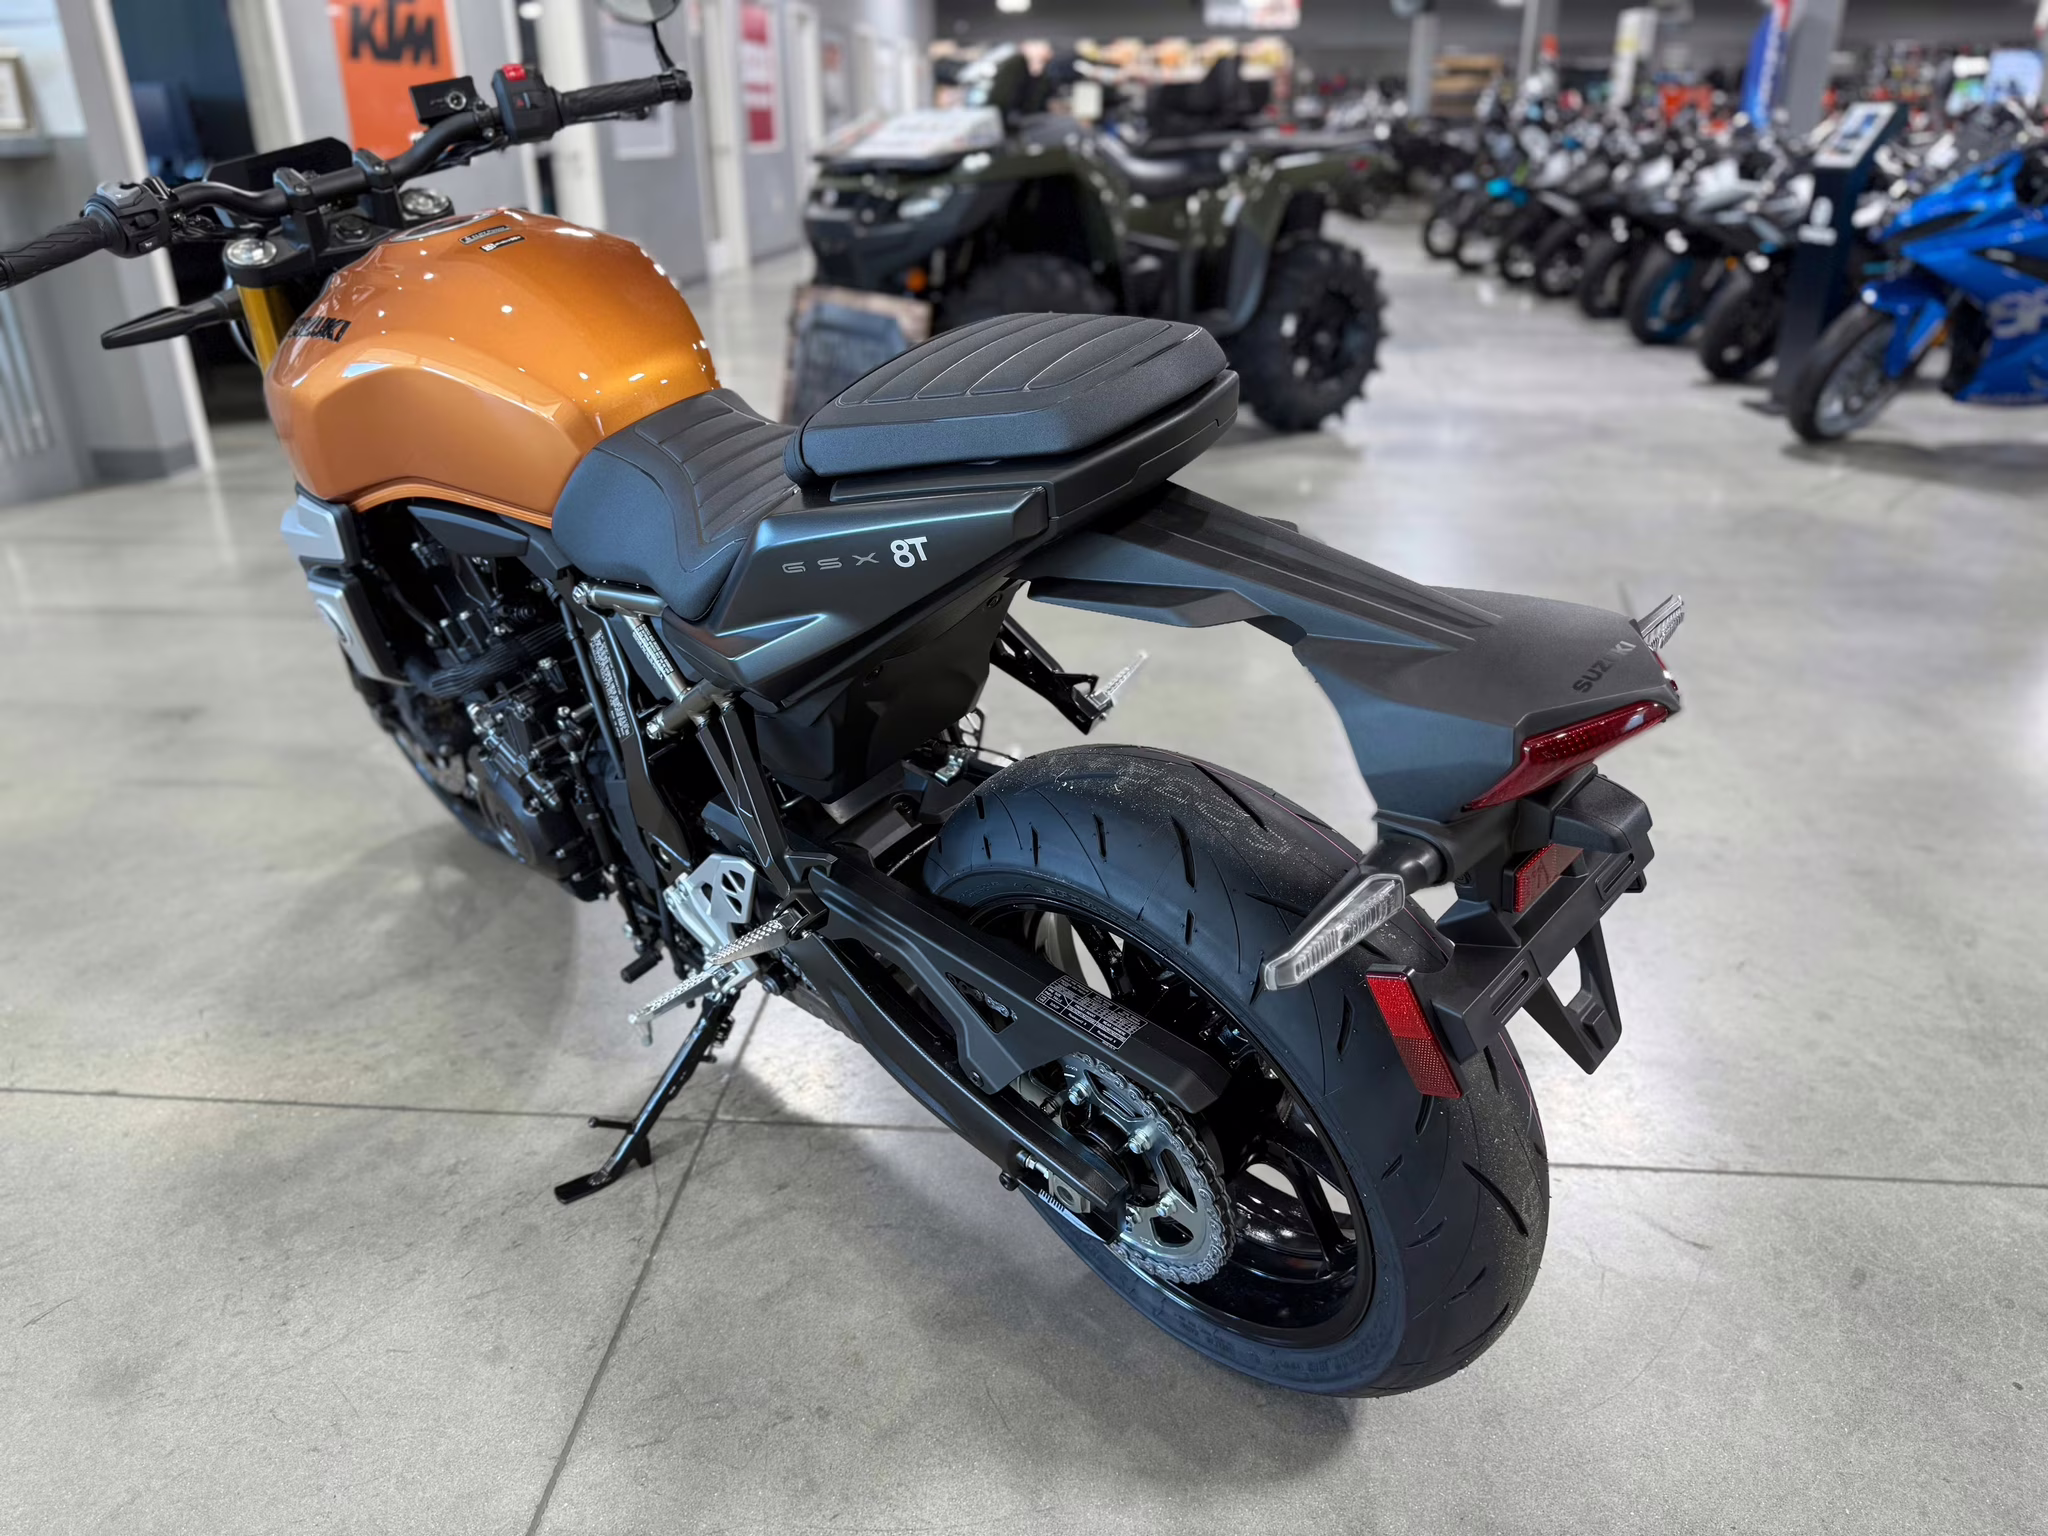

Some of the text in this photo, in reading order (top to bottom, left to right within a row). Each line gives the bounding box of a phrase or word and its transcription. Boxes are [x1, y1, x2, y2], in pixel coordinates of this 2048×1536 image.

[350, 0, 437, 65] KTM
[782, 536, 928, 574] GSX 8T
